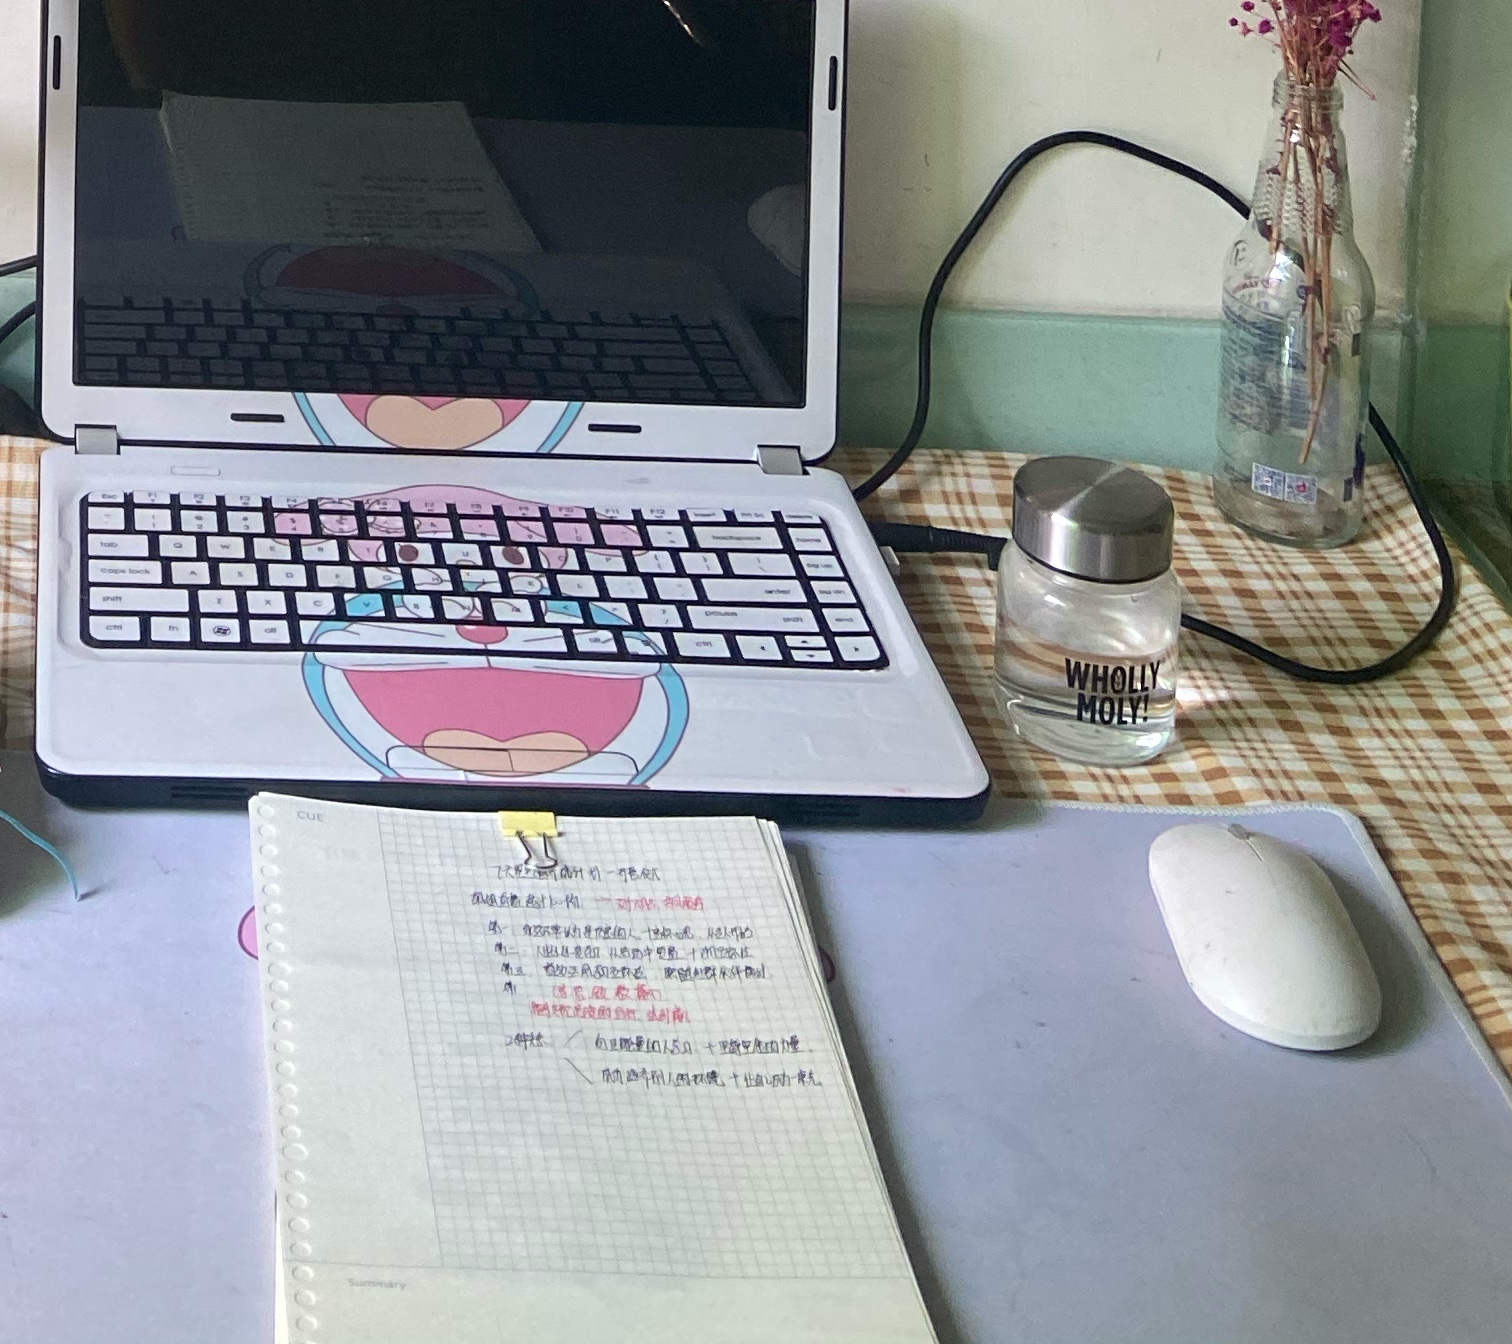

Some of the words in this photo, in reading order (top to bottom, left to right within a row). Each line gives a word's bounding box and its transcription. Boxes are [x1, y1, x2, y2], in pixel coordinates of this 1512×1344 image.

[1064, 657, 1162, 694] WHOLLY
[1075, 691, 1151, 726] MOLY!
[295, 808, 326, 824] CUE
